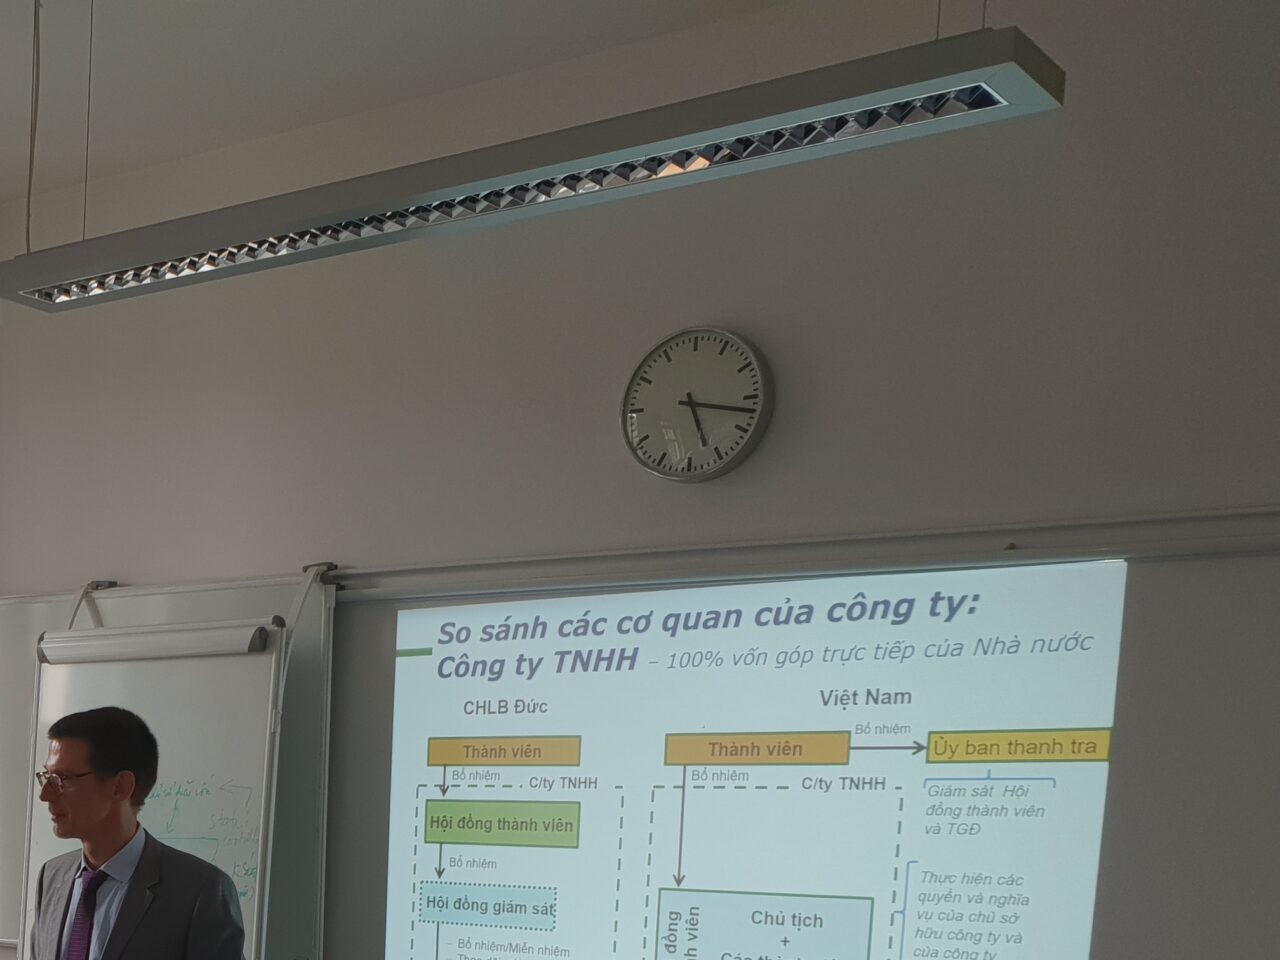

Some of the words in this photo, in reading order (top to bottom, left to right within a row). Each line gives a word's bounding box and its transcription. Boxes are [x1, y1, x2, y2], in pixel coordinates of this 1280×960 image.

[437, 622, 471, 645] So
[480, 614, 547, 642] sánh
[558, 611, 607, 638] các
[617, 611, 652, 634] cơ
[662, 608, 742, 637] quan
[754, 598, 814, 626] của
[827, 592, 915, 625] công
[929, 591, 980, 622] ty:
[437, 653, 504, 681] Công
[515, 654, 542, 680] ty
[555, 647, 639, 674] TNHH
[667, 650, 723, 669] 100%
[732, 645, 768, 666] vốn
[775, 644, 814, 668] góp
[822, 644, 865, 666] trực
[873, 642, 915, 663] tiếp
[924, 638, 963, 658] của
[973, 636, 1020, 656] Nhà
[1030, 632, 1095, 652] nước
[464, 700, 509, 715] CHLB
[514, 699, 548, 714] Đức
[819, 689, 858, 710] Việt
[865, 688, 912, 705] Nam
[464, 744, 506, 759] Thành
[510, 745, 541, 759] viên
[708, 741, 761, 757] Thành
[767, 742, 803, 756] viên
[965, 740, 1000, 756] ban
[1008, 739, 1064, 755] thanh
[1070, 739, 1097, 754] tra
[529, 776, 554, 792] C/ty
[560, 776, 598, 789] TNHH
[801, 777, 832, 793] C/ty
[840, 777, 886, 791] TNHH
[1011, 805, 1045, 818] viên
[430, 815, 454, 831] Hội
[457, 813, 492, 833] đồng
[497, 817, 539, 832] thành
[542, 818, 574, 833] viên
[946, 822, 981, 836] TGĐ
[997, 873, 1024, 887] các
[426, 896, 449, 912] Hội
[453, 895, 488, 915] đồng
[492, 898, 527, 917] giám
[532, 899, 555, 917] sát
[686, 906, 700, 943] viên
[751, 910, 786, 927] Chủ
[791, 912, 824, 931] tịch
[662, 911, 682, 954] đồng
[947, 929, 983, 945] công
[987, 931, 1001, 946] ty
